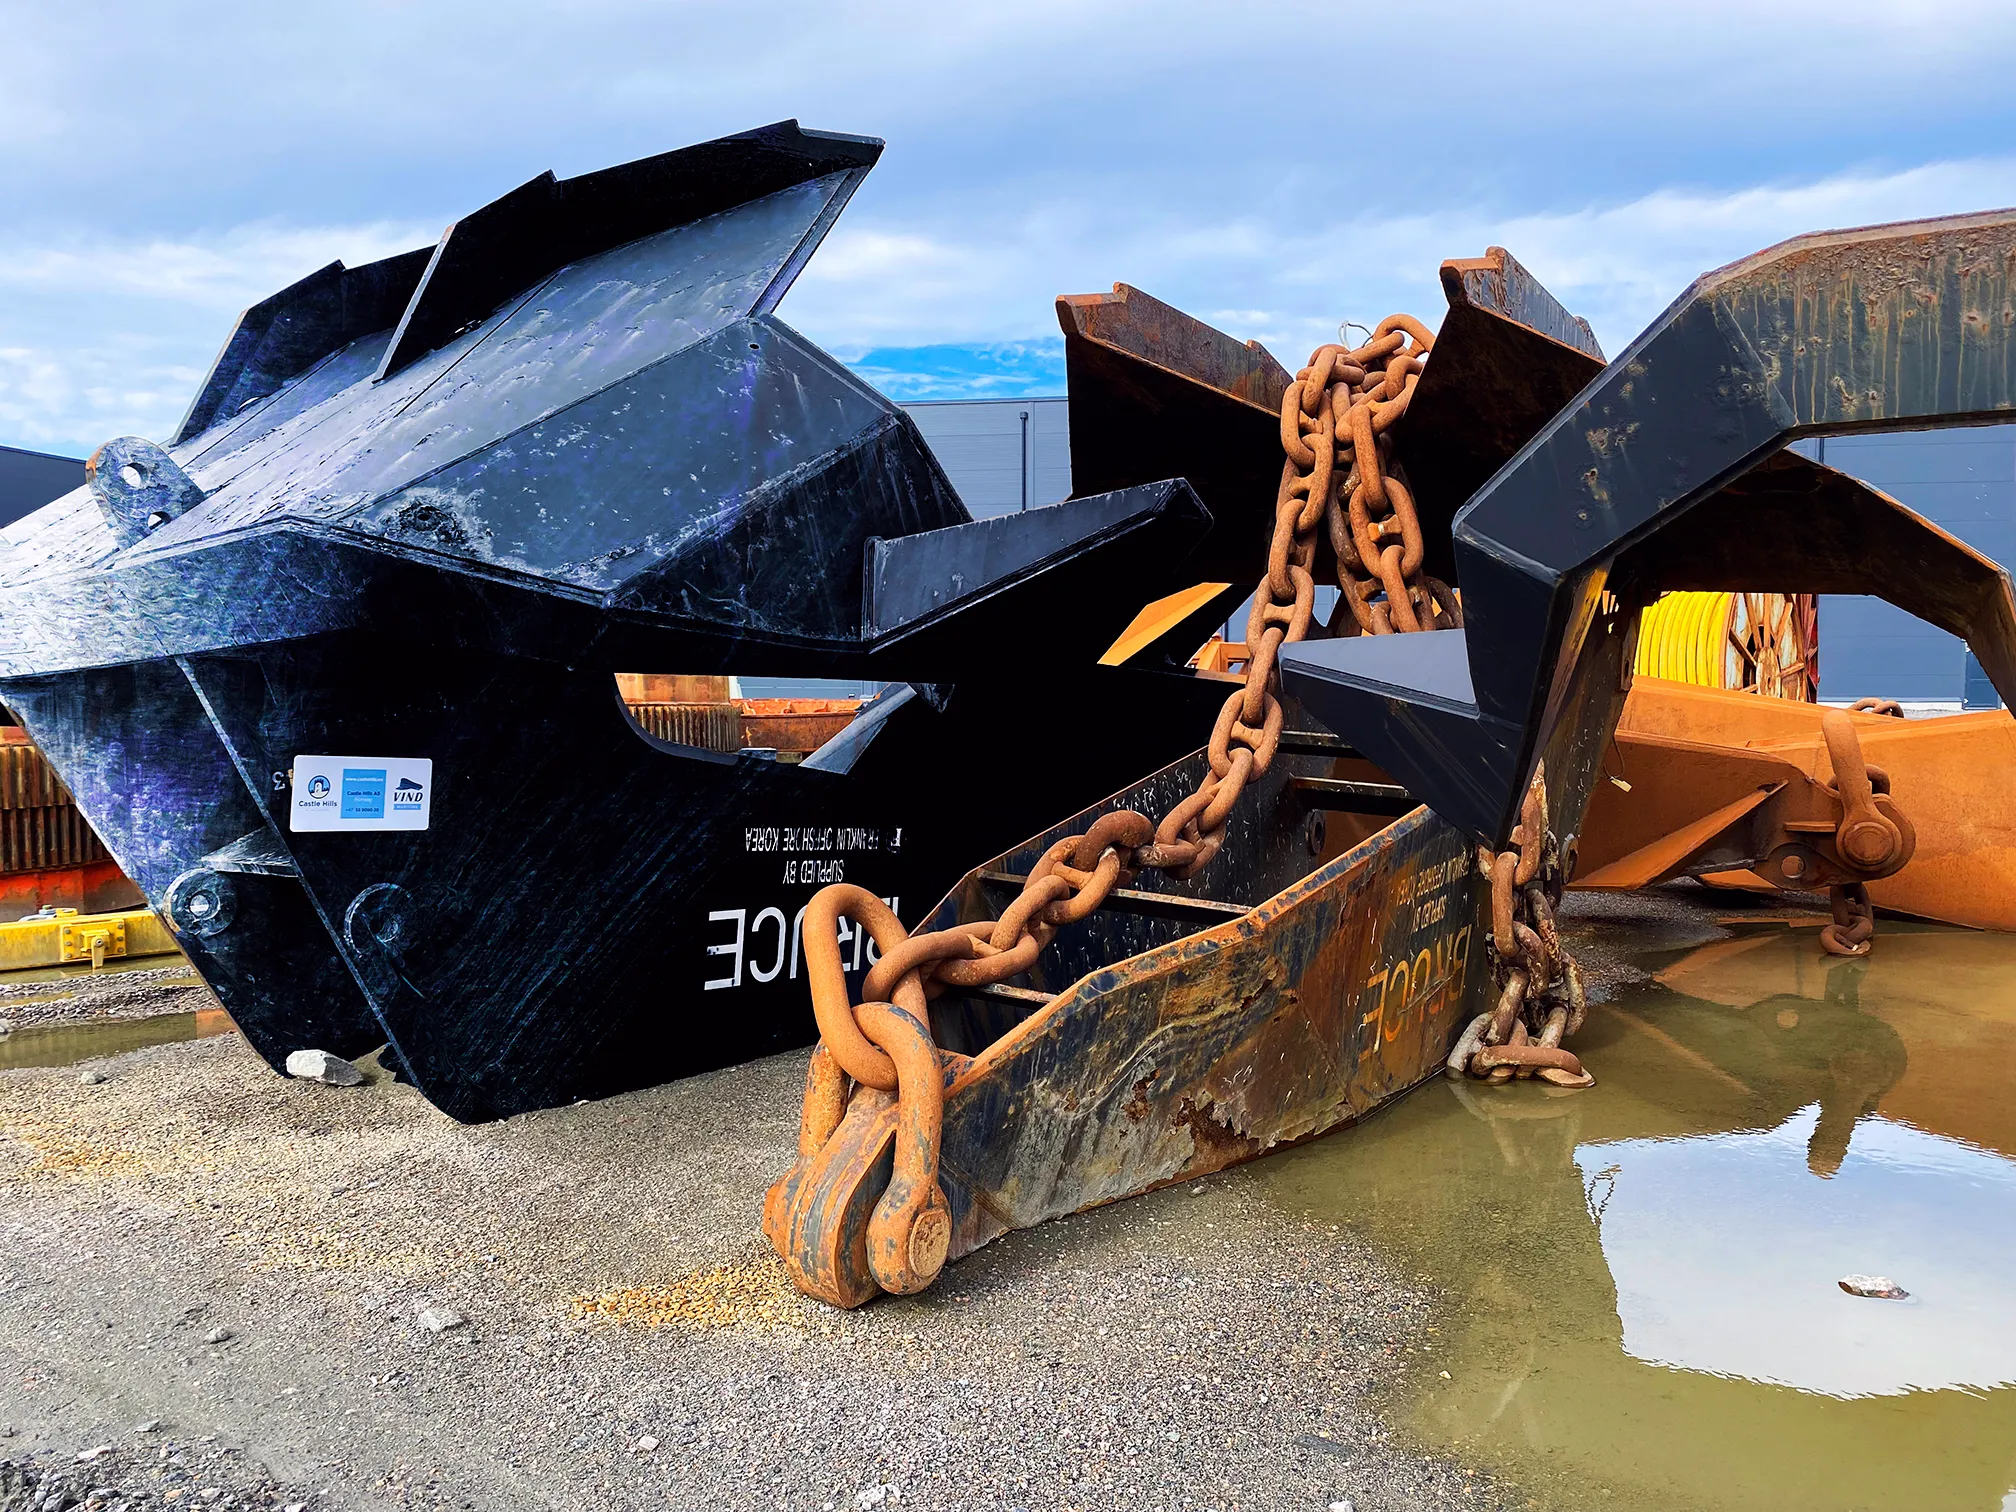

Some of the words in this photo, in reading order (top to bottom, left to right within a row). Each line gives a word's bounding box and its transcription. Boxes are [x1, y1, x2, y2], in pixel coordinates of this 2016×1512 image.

[394, 792, 423, 802] VIND
[745, 828, 780, 851] KOREA
[782, 828, 832, 851] OFFSHORE
[836, 828, 879, 850] FRANKLIN
[782, 860, 796, 884] BY
[800, 859, 844, 883] SUPPLIED
[1358, 923, 1472, 1063] BRUCE
